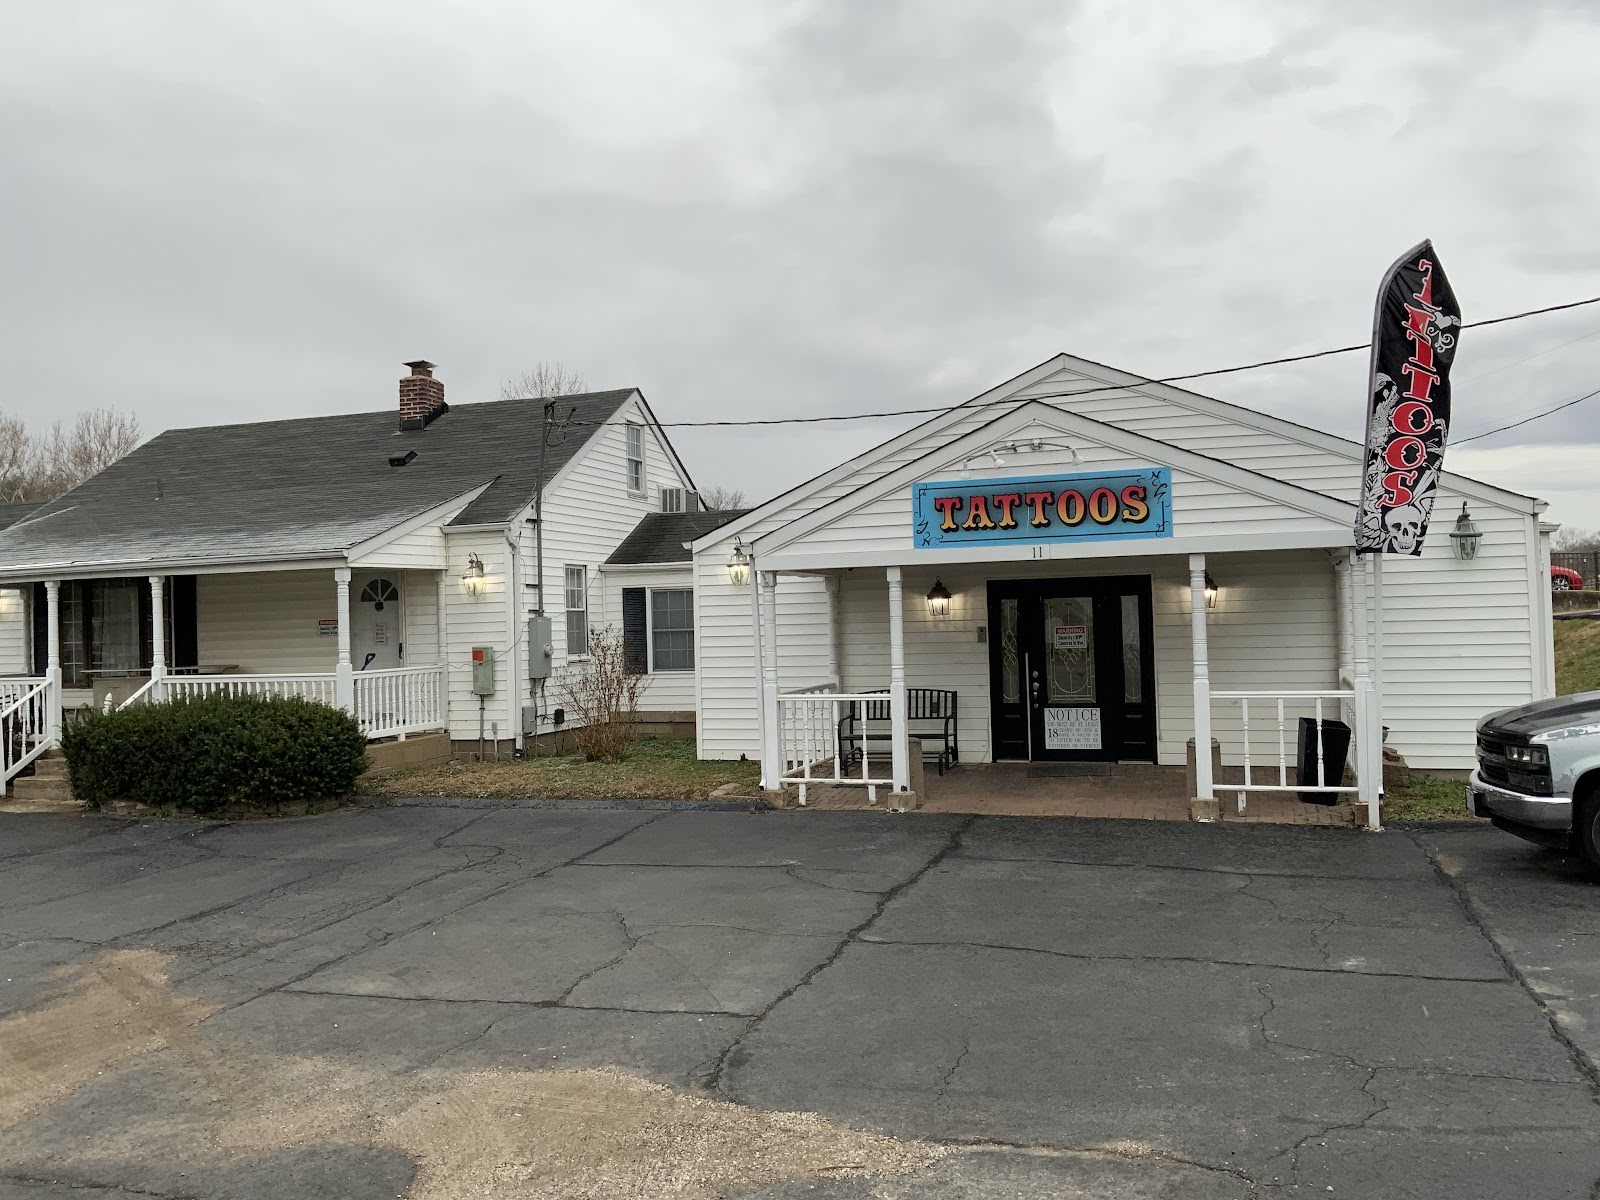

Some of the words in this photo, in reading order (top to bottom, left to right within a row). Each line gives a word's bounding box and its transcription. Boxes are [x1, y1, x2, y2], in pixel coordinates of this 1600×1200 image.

[934, 485, 1150, 533] TATTOOS
[1032, 546, 1042, 559] 11
[1048, 709, 1098, 721] NOTICE
[1048, 728, 1058, 738] 18
